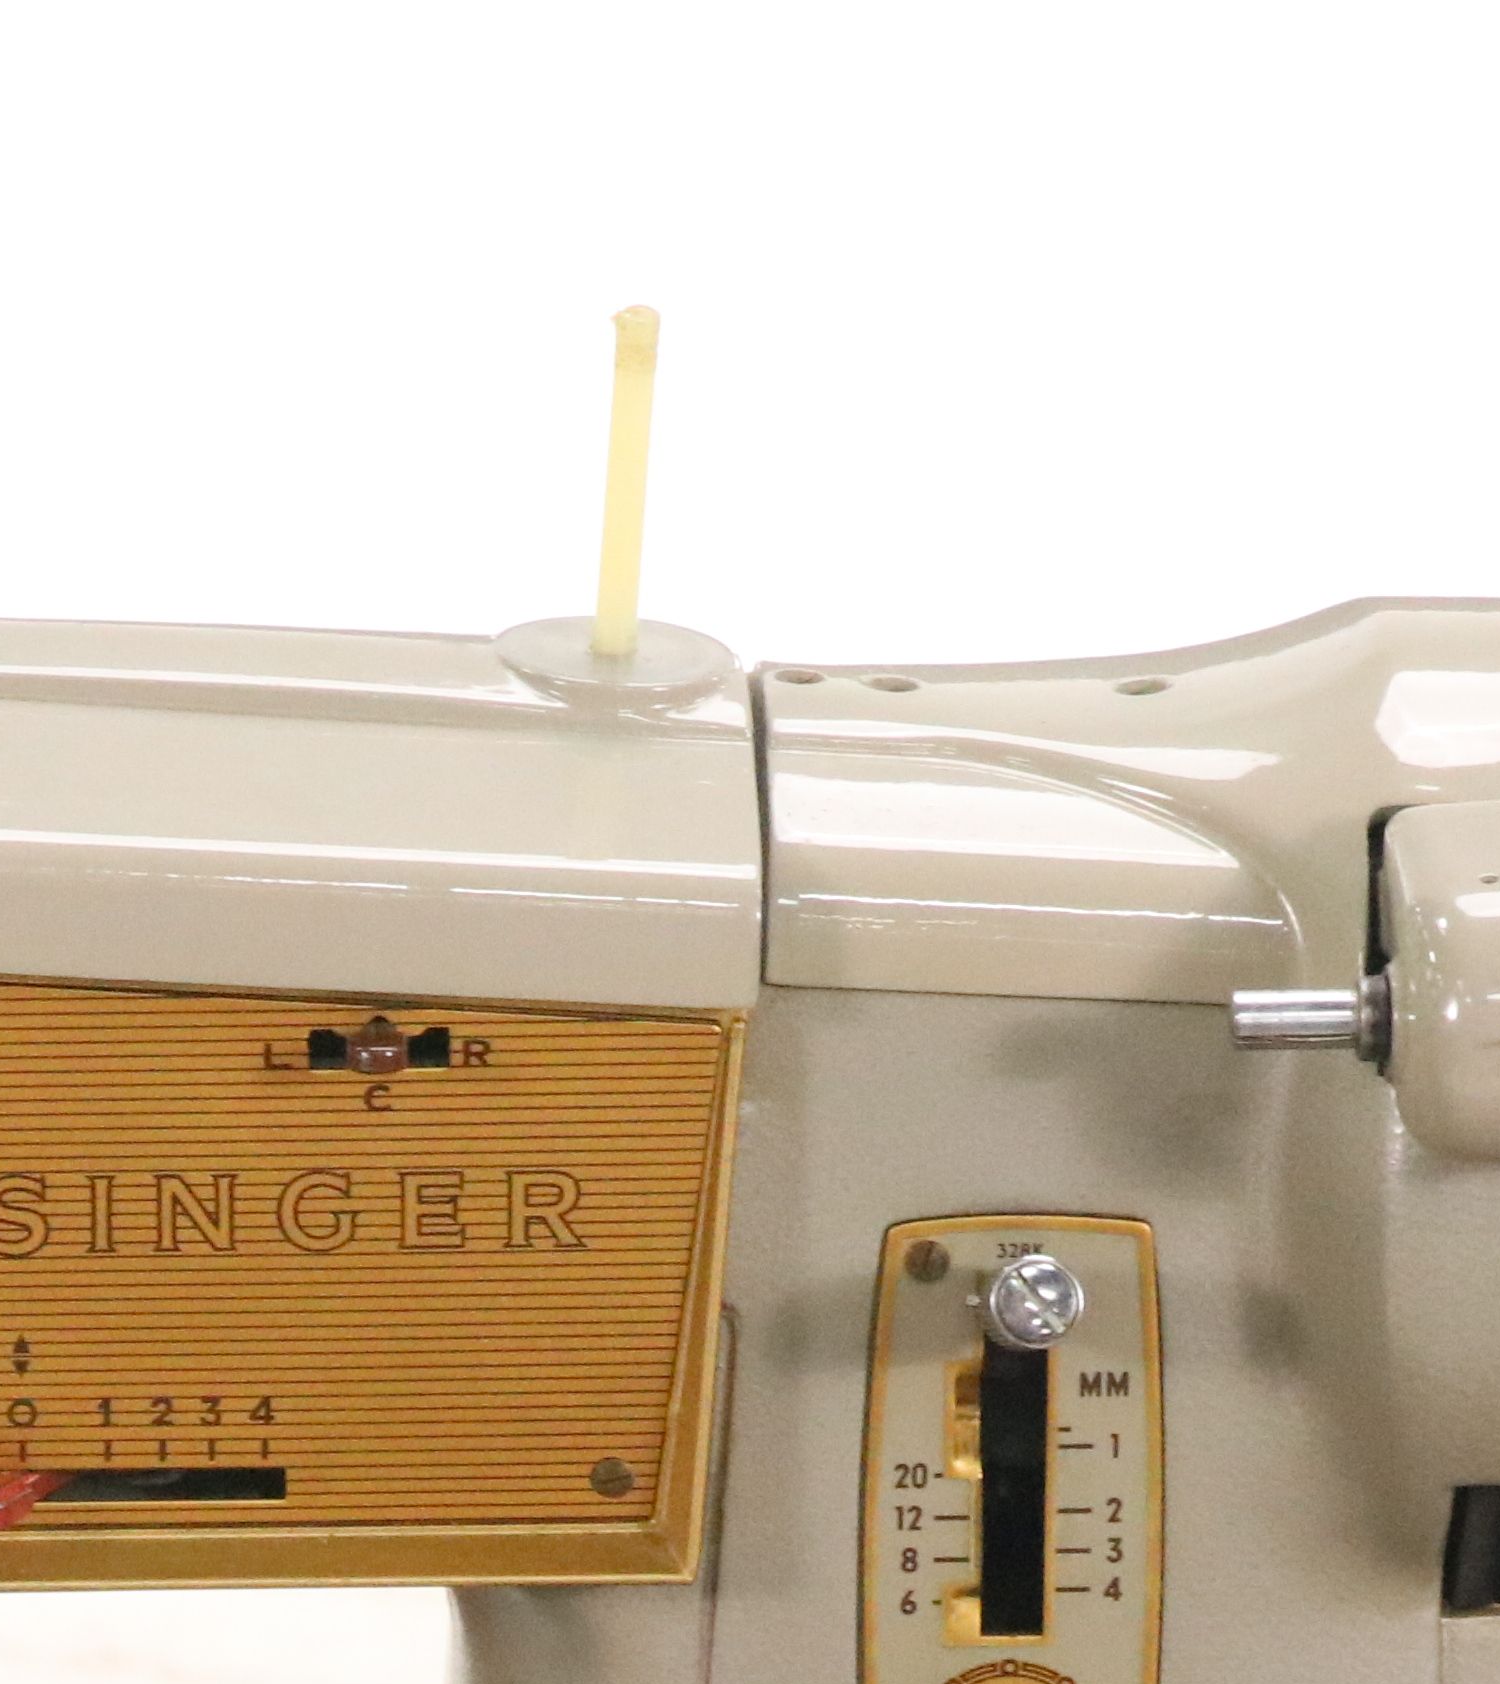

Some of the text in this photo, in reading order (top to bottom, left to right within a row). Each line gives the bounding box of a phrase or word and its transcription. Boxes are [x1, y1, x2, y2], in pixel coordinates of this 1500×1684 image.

[262, 1038, 492, 1070] L R
[363, 1083, 392, 1111] C
[1079, 1370, 1131, 1398] MM
[97, 1397, 113, 1427] 1
[150, 1395, 174, 1427] 2
[200, 1395, 222, 1427] 3
[249, 1395, 276, 1426] 4
[1110, 1432, 1120, 1459] 1
[894, 1462, 929, 1490] 20
[894, 1504, 923, 1532] 12
[1105, 1497, 1124, 1524] 2
[900, 1546, 919, 1573] 8
[1105, 1536, 1124, 1564] 3
[900, 1589, 918, 1616] 6
[1102, 1576, 1124, 1602] 4
